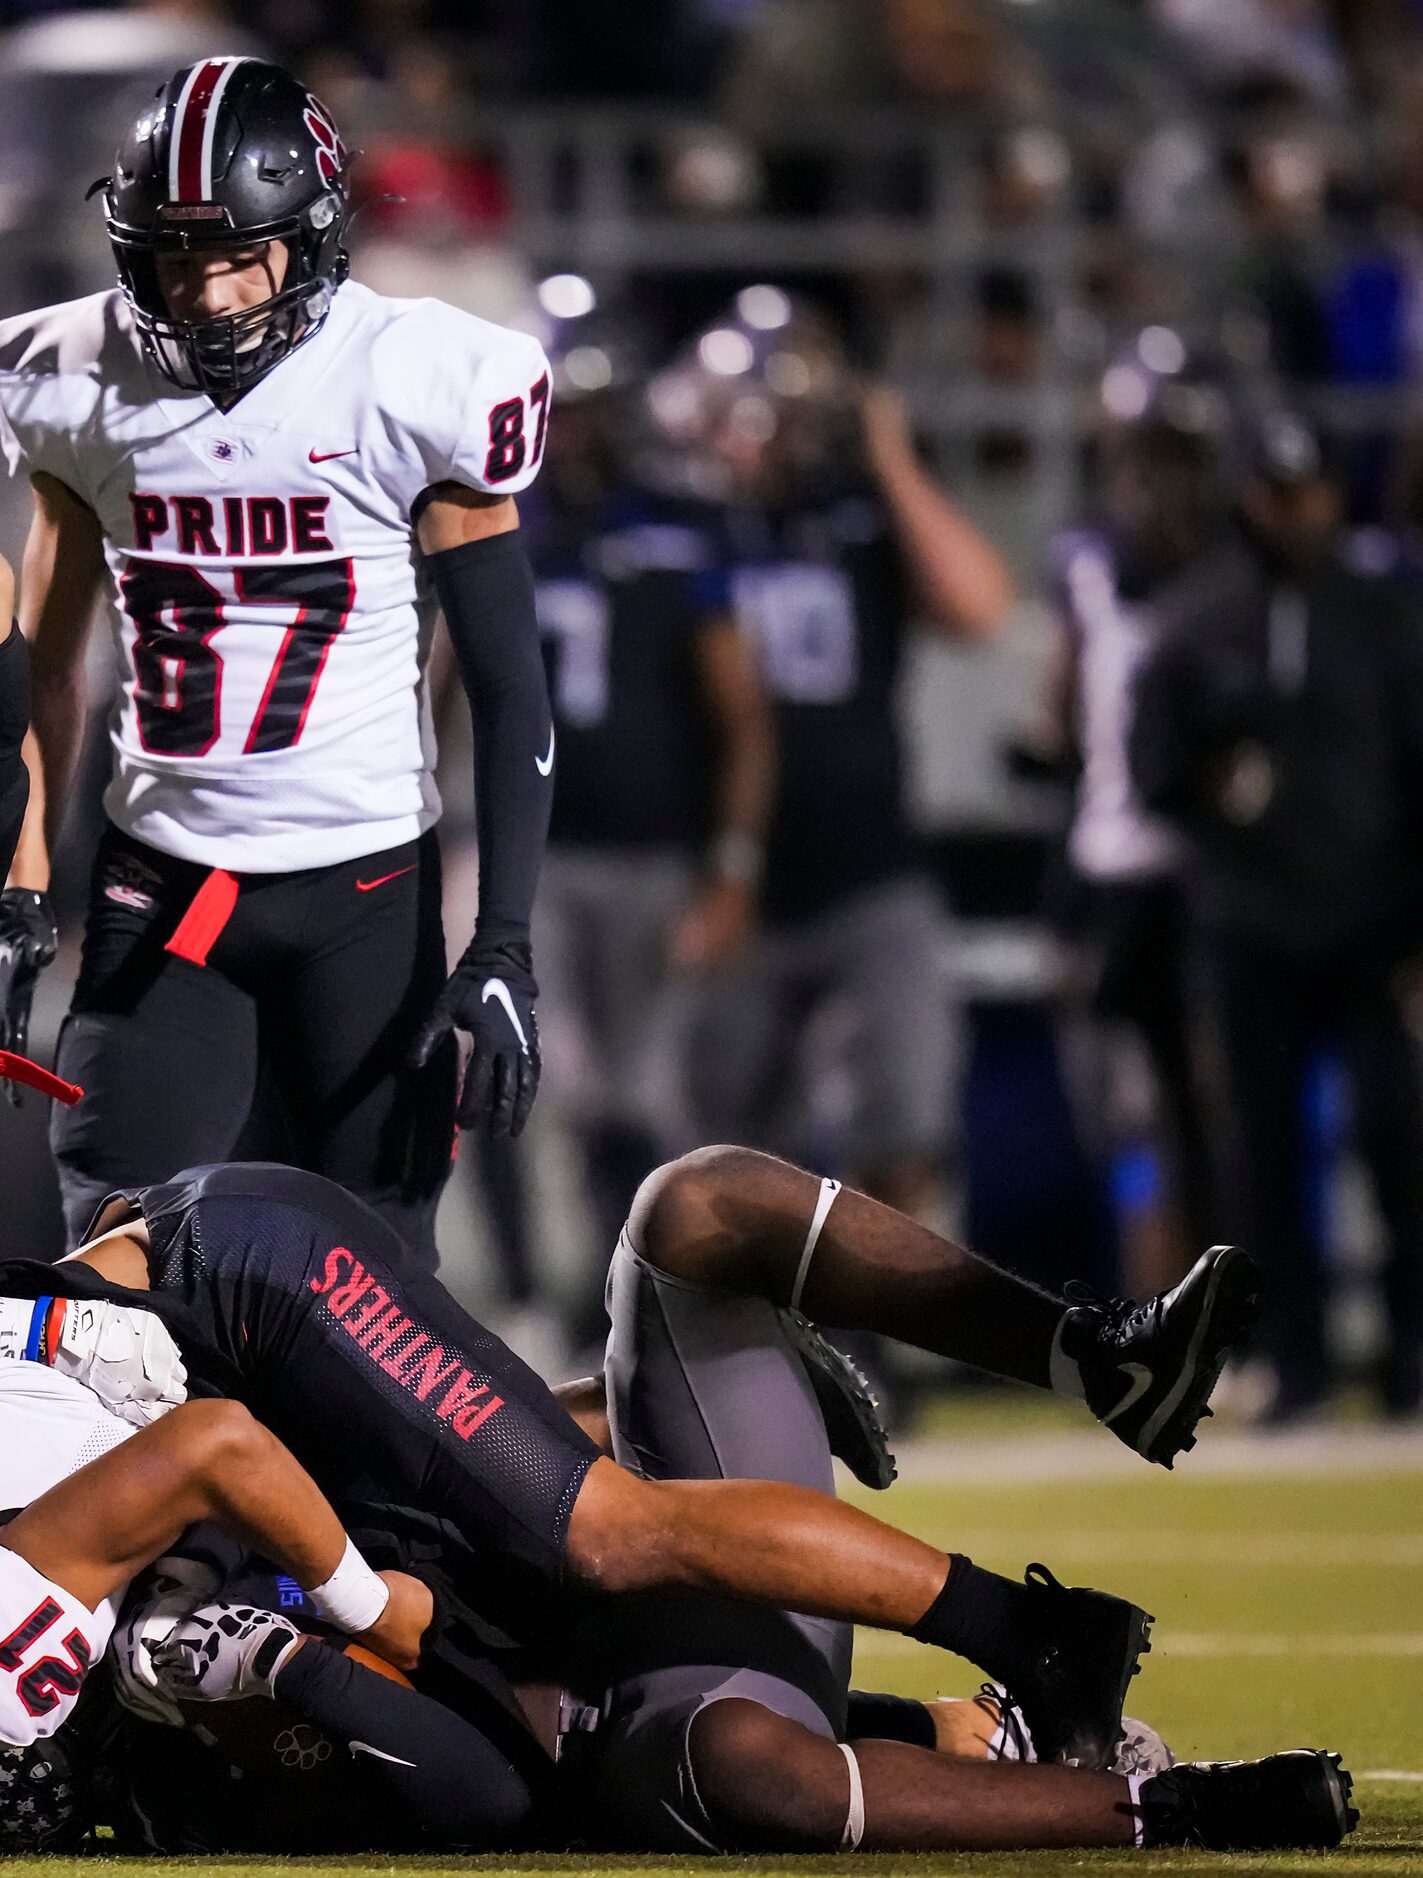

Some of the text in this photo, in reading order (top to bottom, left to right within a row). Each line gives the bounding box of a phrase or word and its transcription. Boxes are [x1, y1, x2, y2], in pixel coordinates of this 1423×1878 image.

[483, 368, 549, 485] 87
[129, 495, 334, 556] PRIDE
[119, 557, 357, 757] 87
[310, 1246, 506, 1442] PANTHERS
